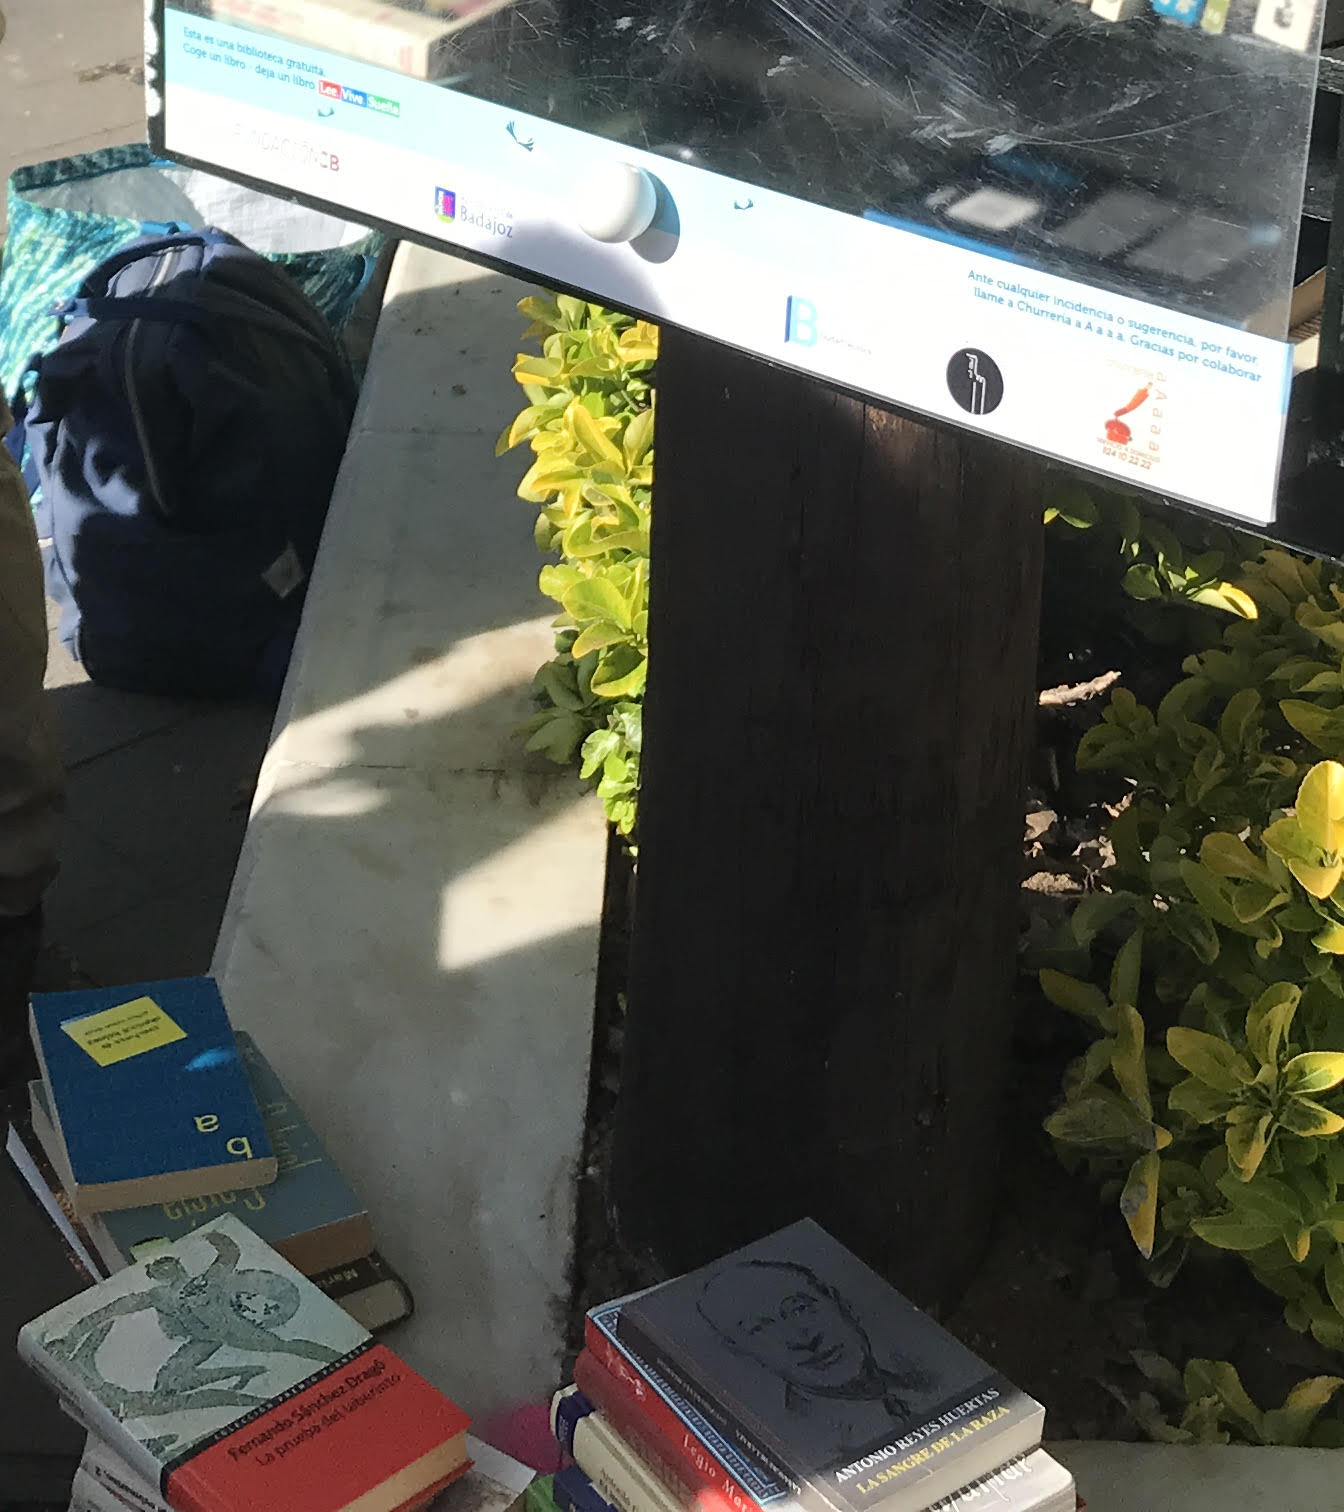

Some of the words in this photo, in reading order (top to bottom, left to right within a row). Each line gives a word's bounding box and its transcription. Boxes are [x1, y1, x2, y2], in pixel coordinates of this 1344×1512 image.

[183, 26, 202, 41] Esta
[204, 34, 214, 45] es
[216, 38, 234, 51] una
[236, 41, 284, 66] biblioteca
[183, 43, 207, 59] Coge
[209, 51, 222, 63] un
[224, 54, 247, 70] libro
[254, 64, 276, 79] deja
[277, 70, 291, 84] un
[292, 71, 316, 90] libro
[460, 204, 513, 239] Badajoz
[968, 269, 994, 286] Ante
[996, 280, 1051, 303] cualquier
[1053, 295, 1114, 323] incidencia
[1116, 316, 1125, 326] o
[1201, 339, 1223, 355] por
[973, 287, 1004, 305] llame
[1085, 321, 1093, 332] A
[1130, 334, 1175, 358] Gracias
[1178, 349, 1199, 366] por
[1202, 356, 1263, 383] colaborar
[227, 1417, 292, 1463] Fernando
[291, 1380, 353, 1426] Sánchez
[344, 1358, 387, 1396] Dragó
[256, 1448, 276, 1468] La
[274, 1419, 325, 1458] prueba
[320, 1407, 346, 1432] del
[833, 1442, 897, 1484] ANTONIO
[896, 1418, 943, 1451] REYES
[937, 1387, 1000, 1428] HUERTAS
[681, 1435, 718, 1478] Legio
[855, 1474, 879, 1495] LA
[876, 1444, 935, 1483] SANGRE
[929, 1434, 955, 1457] DE
[951, 1423, 974, 1445] LA
[971, 1403, 1011, 1434] RAZA
